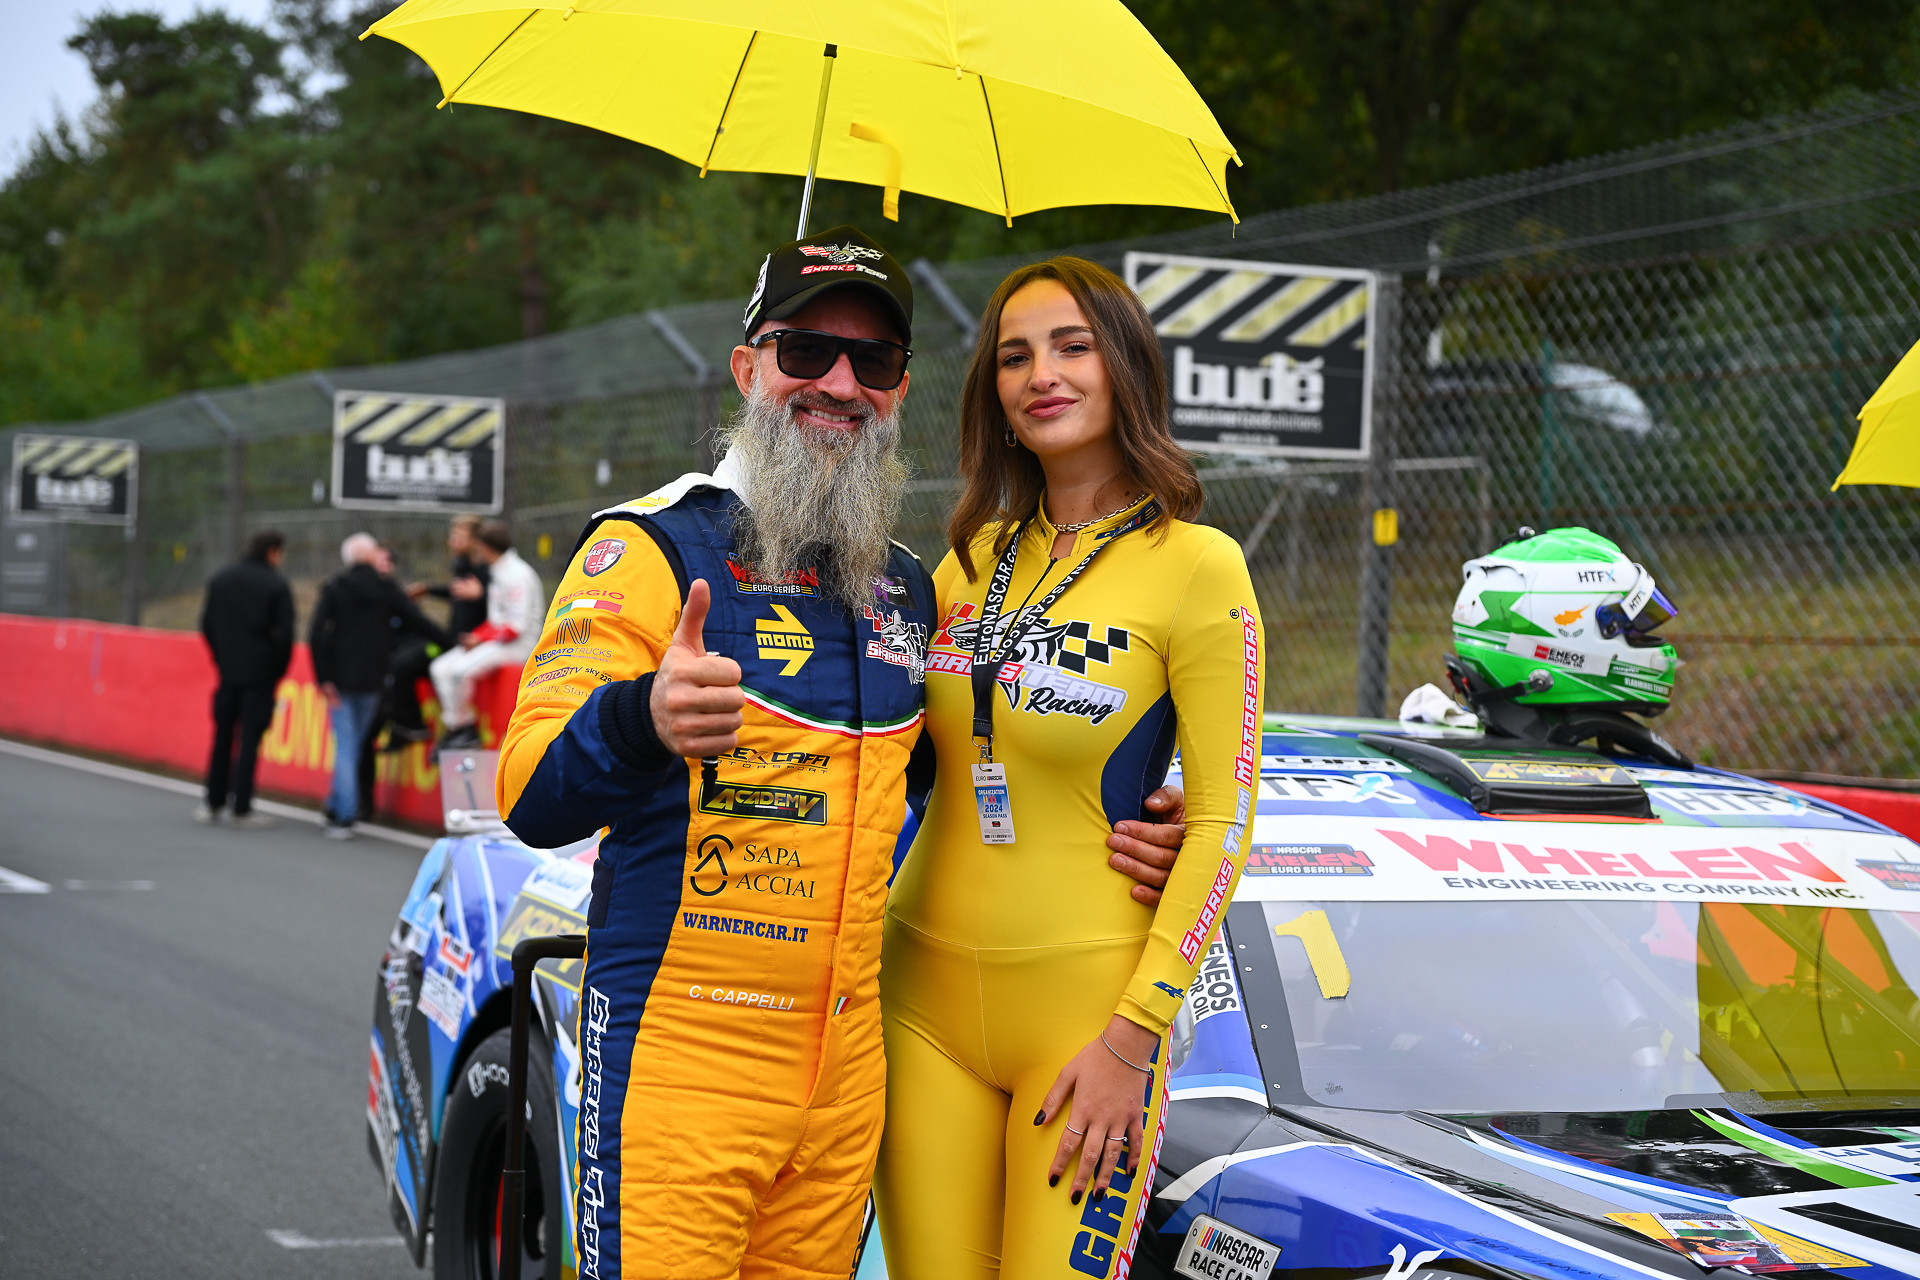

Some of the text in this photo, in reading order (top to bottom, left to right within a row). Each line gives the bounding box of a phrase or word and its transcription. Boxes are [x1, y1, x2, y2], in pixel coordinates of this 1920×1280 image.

[1173, 346, 1325, 412] budé
[1578, 568, 1616, 583] HTFX
[558, 589, 625, 605] RIGGIO
[752, 584, 801, 594] EURO SERIES
[866, 640, 910, 667] SHARKS
[1550, 648, 1586, 662] ENEOS
[585, 667, 600, 678] sky
[1022, 664, 1127, 711] TEAM
[1234, 605, 1259, 788] MOTORSPORT
[1025, 686, 1115, 725] Racing
[718, 759, 828, 775] TORSPORT
[770, 752, 830, 767] CAFFI
[1485, 762, 1617, 783] ACADEMY
[1259, 776, 1404, 799] TFX
[705, 788, 821, 818] ACADEMY
[985, 805, 1004, 813] 2024
[1222, 786, 1251, 857] TEAM
[743, 844, 802, 868] SAPA
[1245, 851, 1375, 867] WHELEN
[1276, 846, 1321, 854] NASCAR
[1374, 827, 1848, 883] WHELEN
[1271, 866, 1344, 874] EURO SERIES
[736, 873, 816, 898] ACCIAI
[1442, 877, 1865, 899] ENGINEERING COMPANY INC.
[1178, 855, 1235, 967] SHARKS
[682, 912, 809, 943] WARNERCAR.IT
[1204, 943, 1237, 1011] ENEOS
[688, 984, 795, 1011] C. CAPPELLI
[1193, 996, 1210, 1020] OIL
[582, 986, 610, 1280] SHARKS TEAM
[1212, 1231, 1265, 1273] NASCAR
[1188, 1251, 1225, 1280] RACE
